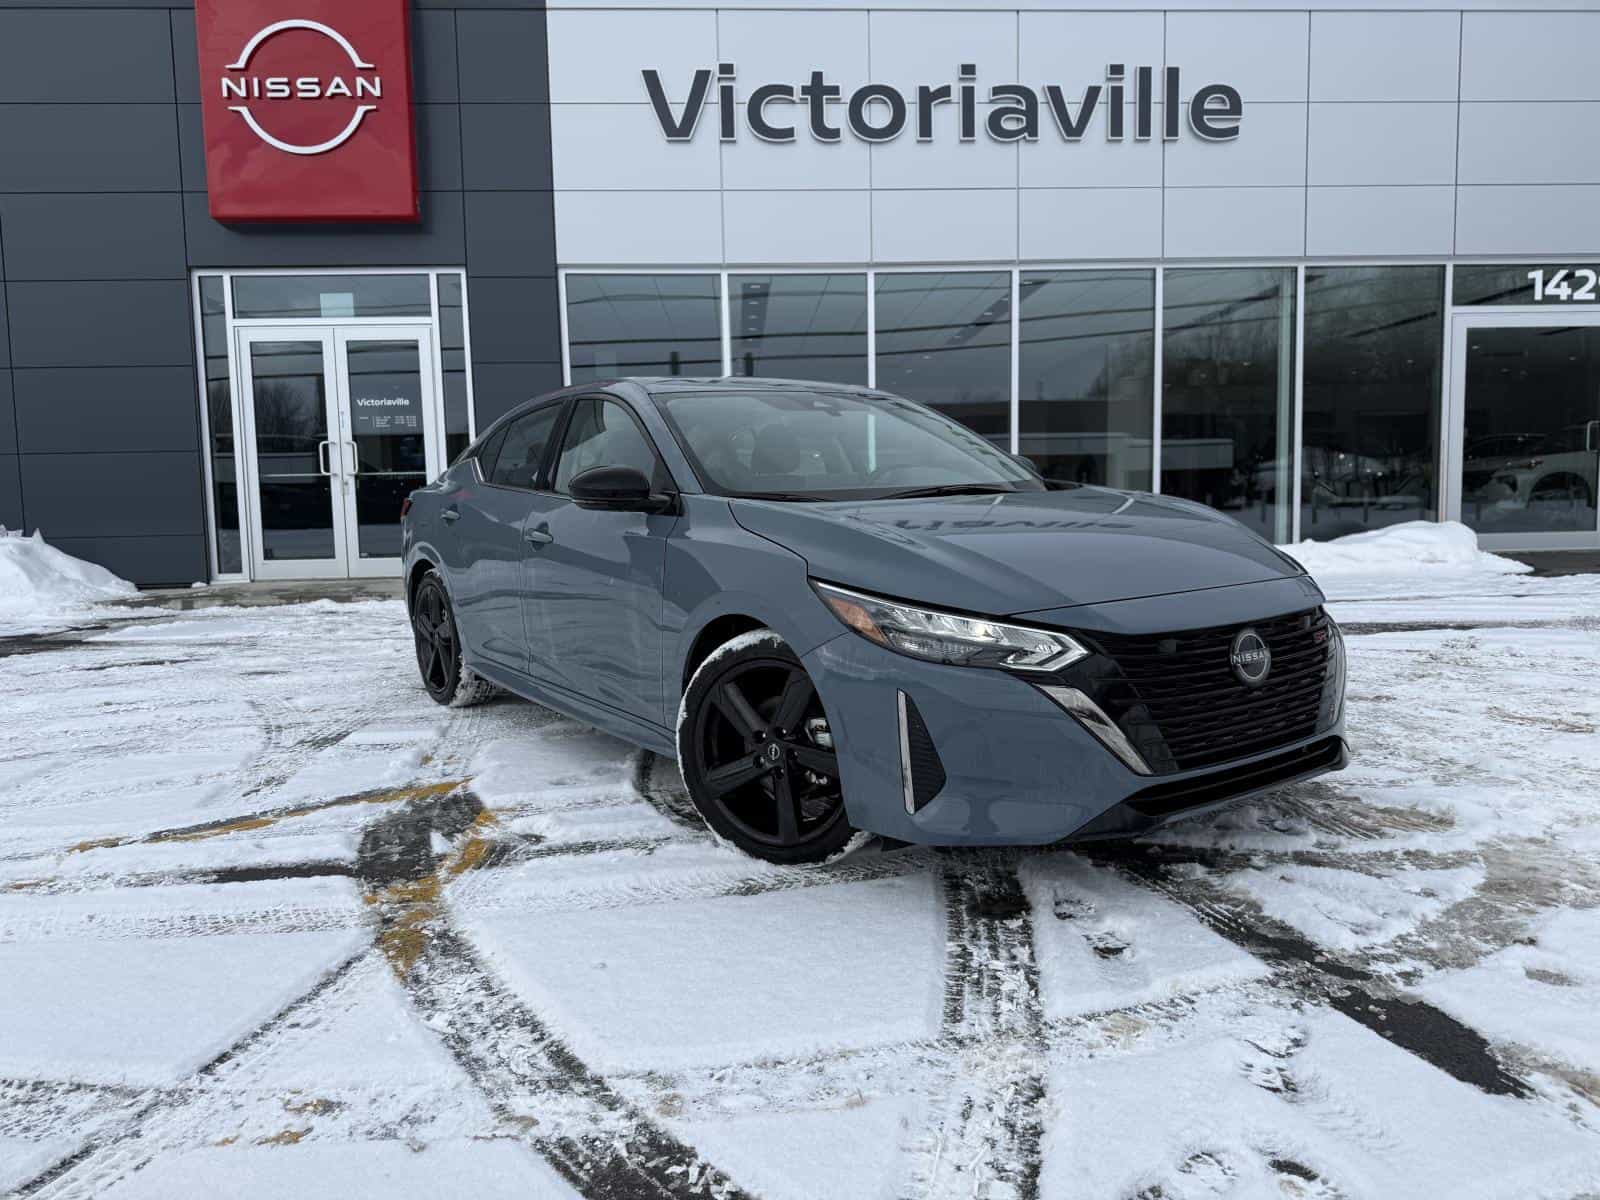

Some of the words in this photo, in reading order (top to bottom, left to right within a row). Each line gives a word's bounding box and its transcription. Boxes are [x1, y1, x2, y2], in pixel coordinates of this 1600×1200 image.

[221, 76, 382, 98] NISSAN
[640, 63, 1243, 143] Victoriaville
[1527, 268, 1600, 301] 142
[357, 398, 410, 406] Victoriaville
[1233, 650, 1268, 664] NISSA
